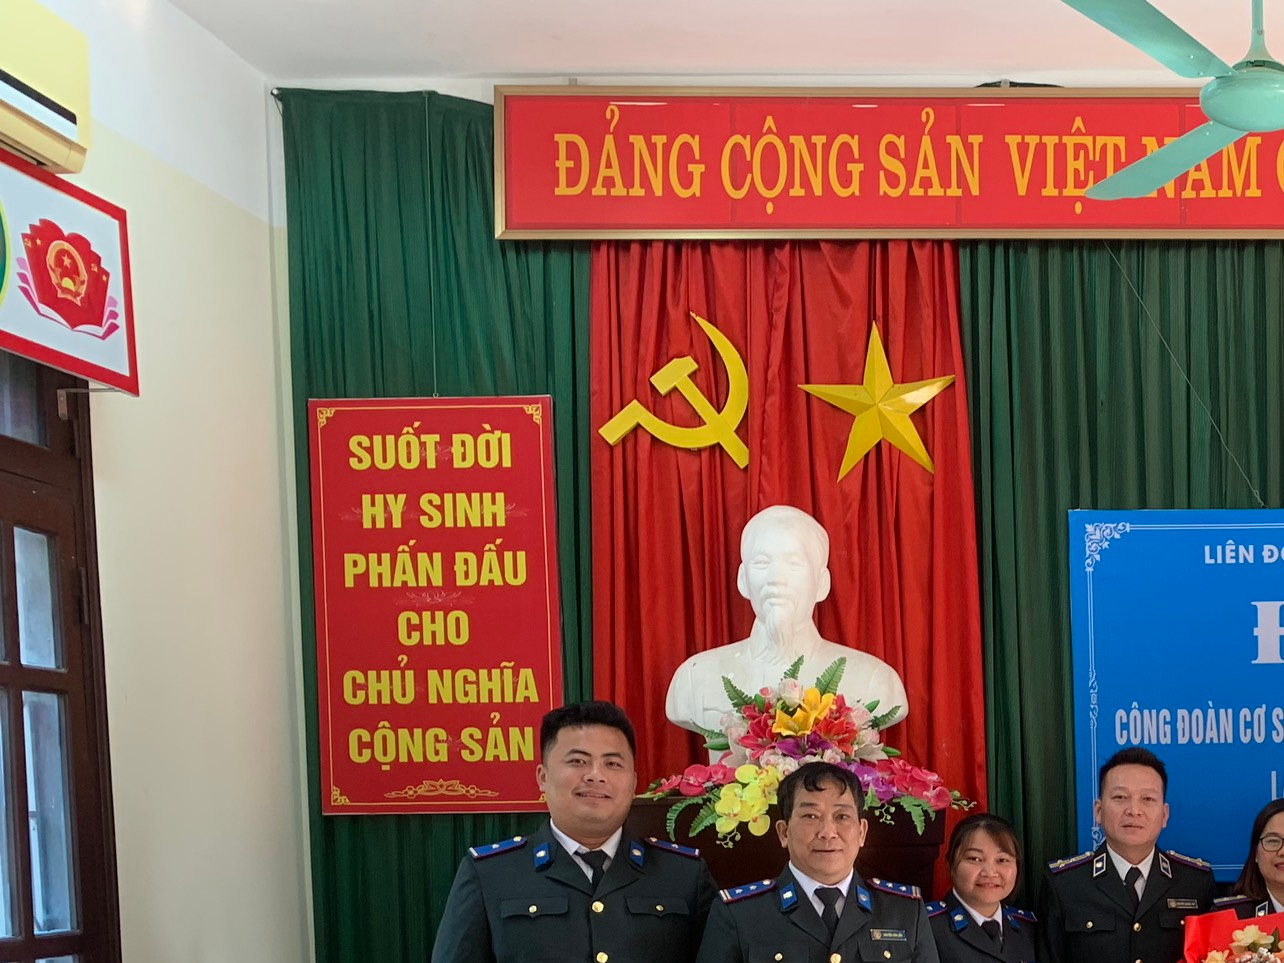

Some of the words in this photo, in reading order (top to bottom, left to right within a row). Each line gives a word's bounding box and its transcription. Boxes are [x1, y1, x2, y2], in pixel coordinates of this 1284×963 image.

[554, 105, 706, 197] ĐẢNG
[721, 116, 864, 214] CỘNG
[878, 107, 982, 197] SẢN
[1005, 117, 1125, 214] VIỆT
[349, 422, 440, 470] SUỐT
[451, 424, 511, 468] ĐỜI
[362, 494, 406, 528] HY
[420, 493, 505, 528] SINH
[344, 540, 442, 587] PHẤN
[454, 539, 526, 586] ĐẤU
[1205, 540, 1253, 563] LIÊN
[398, 611, 469, 645] CHO
[344, 655, 414, 704] CHỦ
[428, 662, 539, 703] NGHĨA
[349, 722, 447, 770] CỘNG
[461, 713, 533, 761] SẢN
[1116, 702, 1171, 745] CÔNG
[1177, 701, 1232, 744] ĐOÀN
[1240, 705, 1266, 743] CƠ
